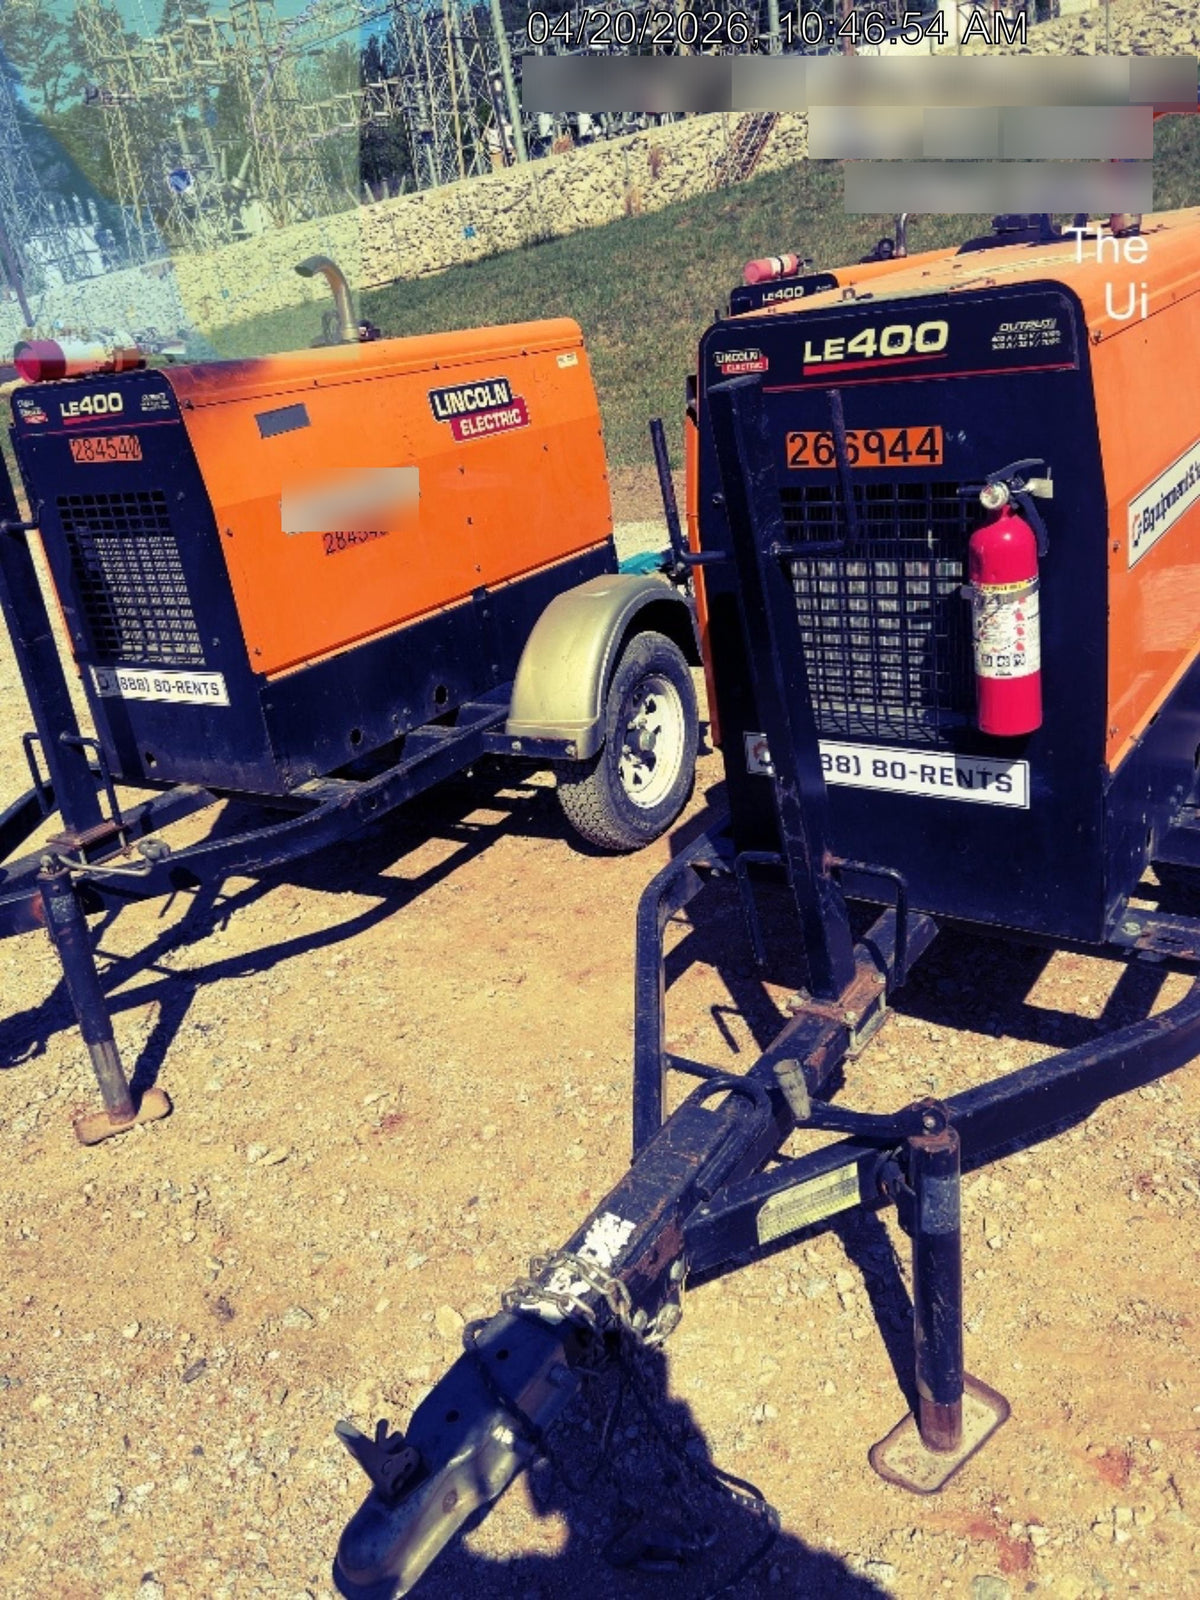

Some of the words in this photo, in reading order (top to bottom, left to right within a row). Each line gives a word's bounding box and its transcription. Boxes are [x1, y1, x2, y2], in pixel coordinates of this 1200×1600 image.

[762, 286, 805, 302] LE400
[803, 319, 950, 364] LE400
[60, 392, 124, 417] LE400
[433, 382, 510, 417] LINCOLN
[459, 408, 522, 437] ELECTRIC
[788, 428, 940, 466] 266944
[153, 678, 220, 697] 80-RENTS
[871, 758, 1014, 794] 80-RENTS
